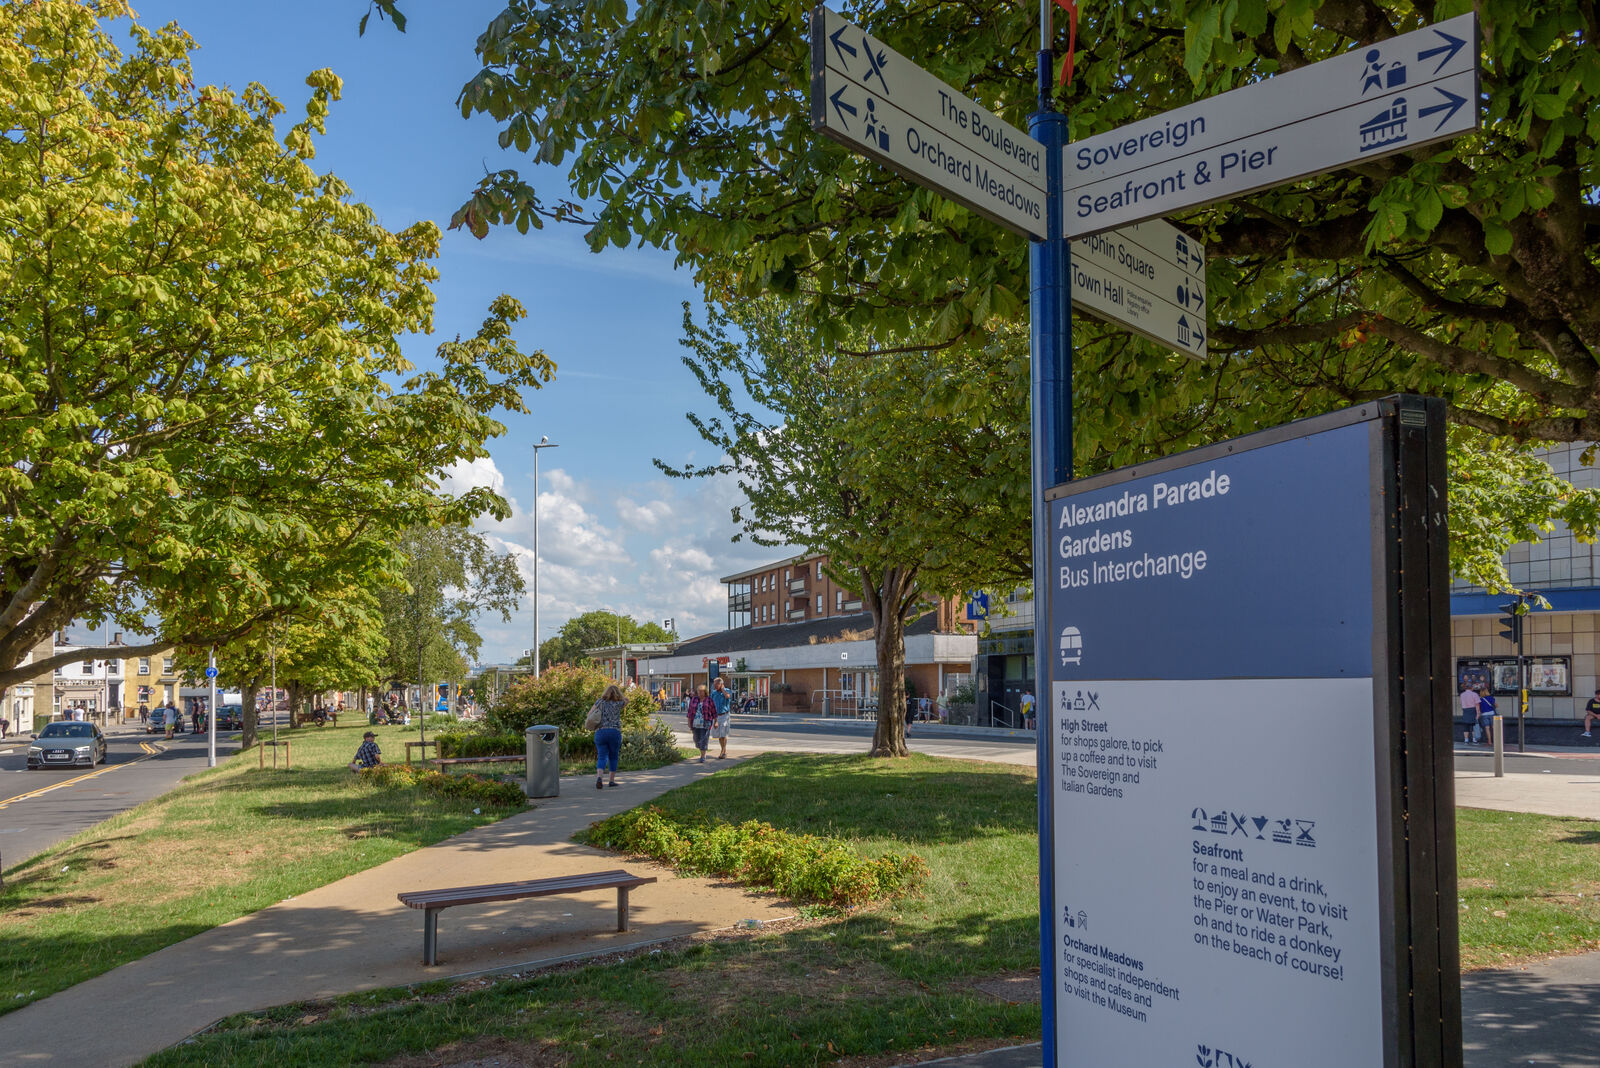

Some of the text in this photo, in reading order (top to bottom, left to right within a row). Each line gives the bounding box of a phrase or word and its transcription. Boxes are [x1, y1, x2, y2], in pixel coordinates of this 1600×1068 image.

[938, 89, 1040, 172] The Boulevard
[1076, 116, 1206, 170] Sovereign
[906, 127, 1040, 220] Orchard Meadows
[1076, 145, 1278, 218] Seafront & Pier
[1081, 234, 1155, 280] olphin Square
[1071, 262, 1124, 306] Town Hall
[1059, 470, 1231, 529] Alexandra Parade
[1060, 529, 1132, 559] Gardens
[1060, 550, 1208, 589] Bus Interchange
[1061, 718, 1108, 733] High Street
[1061, 733, 1163, 754] for shops galore, to pick
[1061, 751, 1157, 768] up a coffee and to visit
[1061, 764, 1140, 784] The Sovereign and
[1062, 779, 1123, 798] Italian Gardens
[1192, 840, 1243, 862] Seafront
[1193, 857, 1327, 898] for a meal and a drink,
[1193, 877, 1348, 921] to enjoy an event, to visit
[1194, 895, 1333, 940] the Pier or Water Park,
[1194, 913, 1341, 963] oh and to ride a donkey
[1064, 934, 1144, 971] Orchard Meadows
[1194, 933, 1344, 981] on the beach of course!
[1064, 949, 1180, 1000] for specialist independent
[1064, 966, 1152, 1008] shops and cafes and
[1064, 982, 1147, 1022] to visit the Museum
